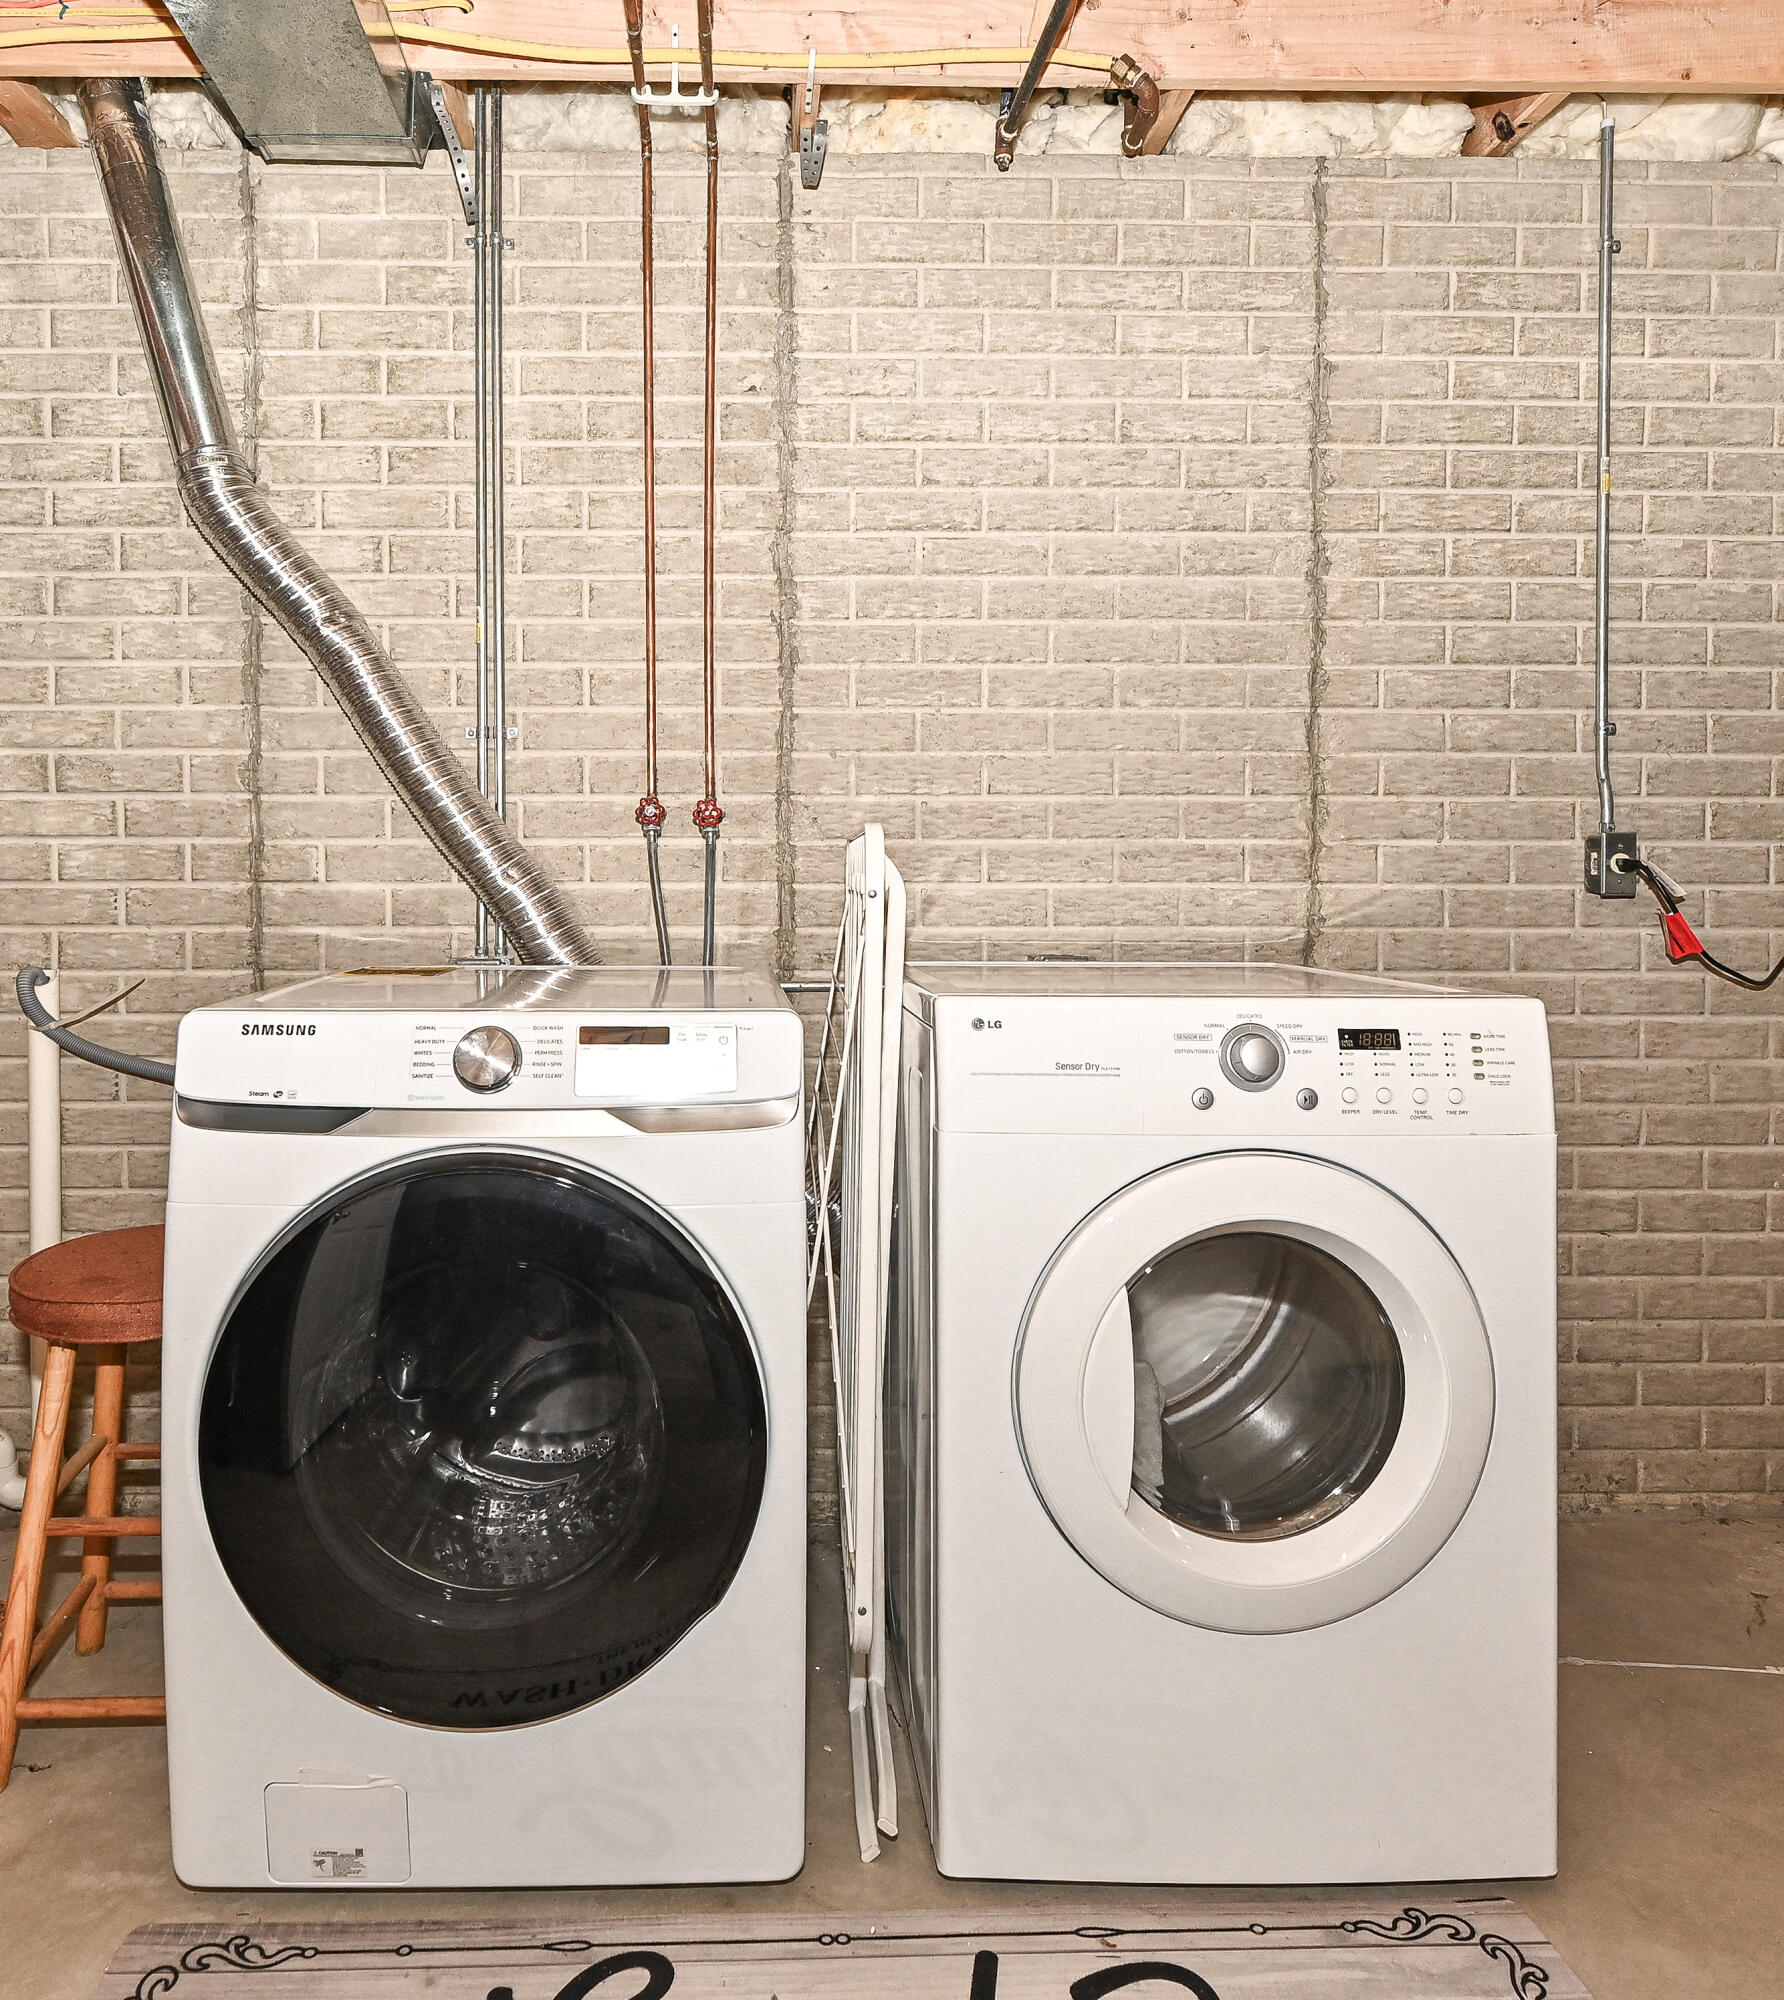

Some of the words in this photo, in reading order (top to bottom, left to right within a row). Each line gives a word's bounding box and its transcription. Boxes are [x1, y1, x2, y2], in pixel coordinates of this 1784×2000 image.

[987, 1020, 1003, 1029] LG
[241, 1024, 316, 1036] SAMSUNG
[1055, 1062, 1083, 1071] Sensor
[1085, 1062, 1100, 1072] Dry
